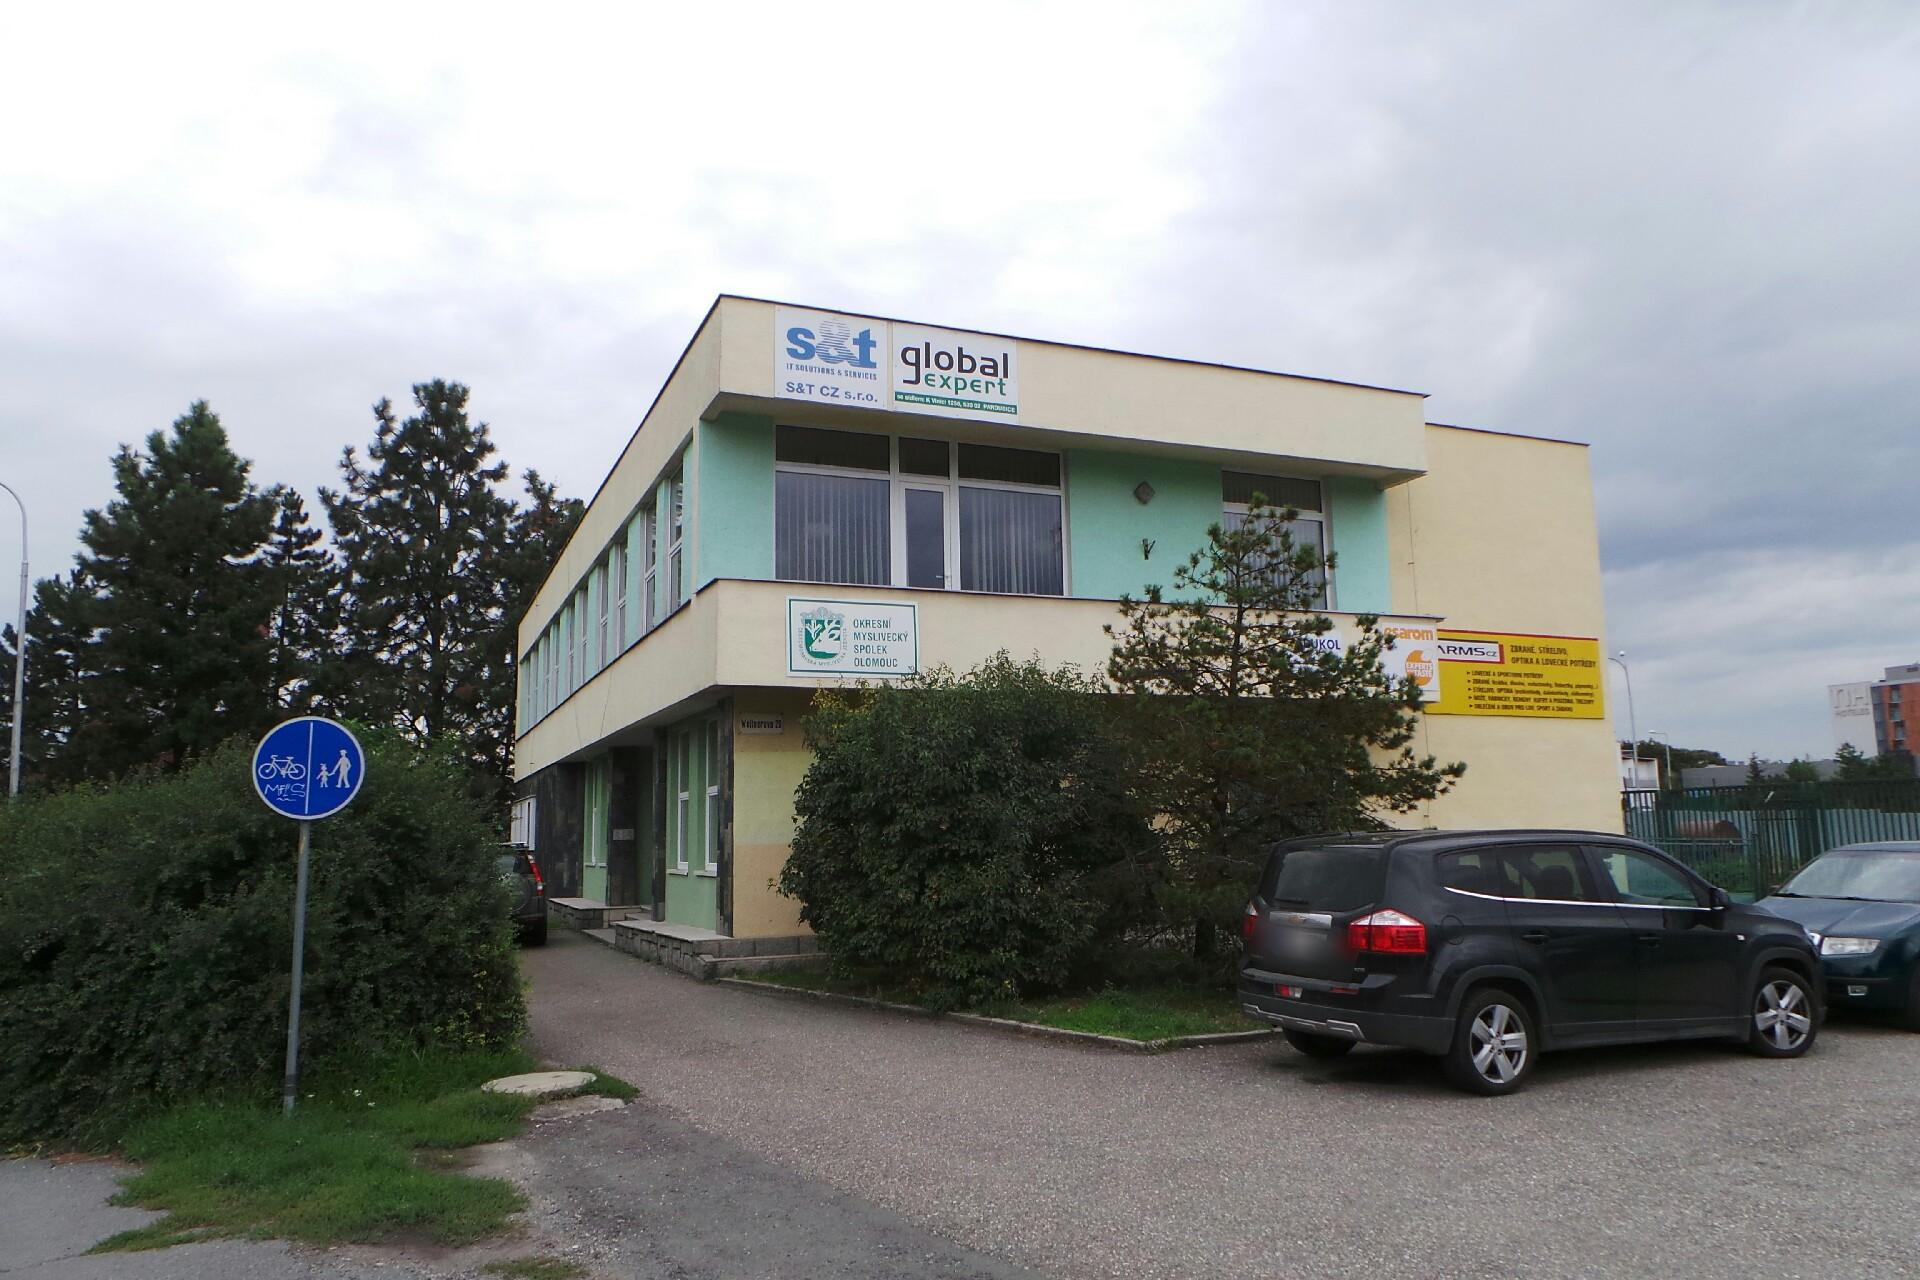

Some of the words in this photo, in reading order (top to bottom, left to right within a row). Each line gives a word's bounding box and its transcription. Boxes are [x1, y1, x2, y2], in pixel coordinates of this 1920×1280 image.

[901, 341, 1008, 385] global
[795, 364, 835, 376] SOLUTIONS
[845, 370, 877, 381] SERVICES
[786, 381, 815, 394] S&T
[820, 386, 840, 398] CZ
[844, 391, 878, 402] s.r.o.
[924, 373, 1006, 396] expert
[853, 617, 891, 629] OKRESNÍ
[853, 631, 908, 643] MYSLIVECKÝ
[853, 644, 887, 654] SPOLEK
[854, 658, 898, 668] OLOMOUC
